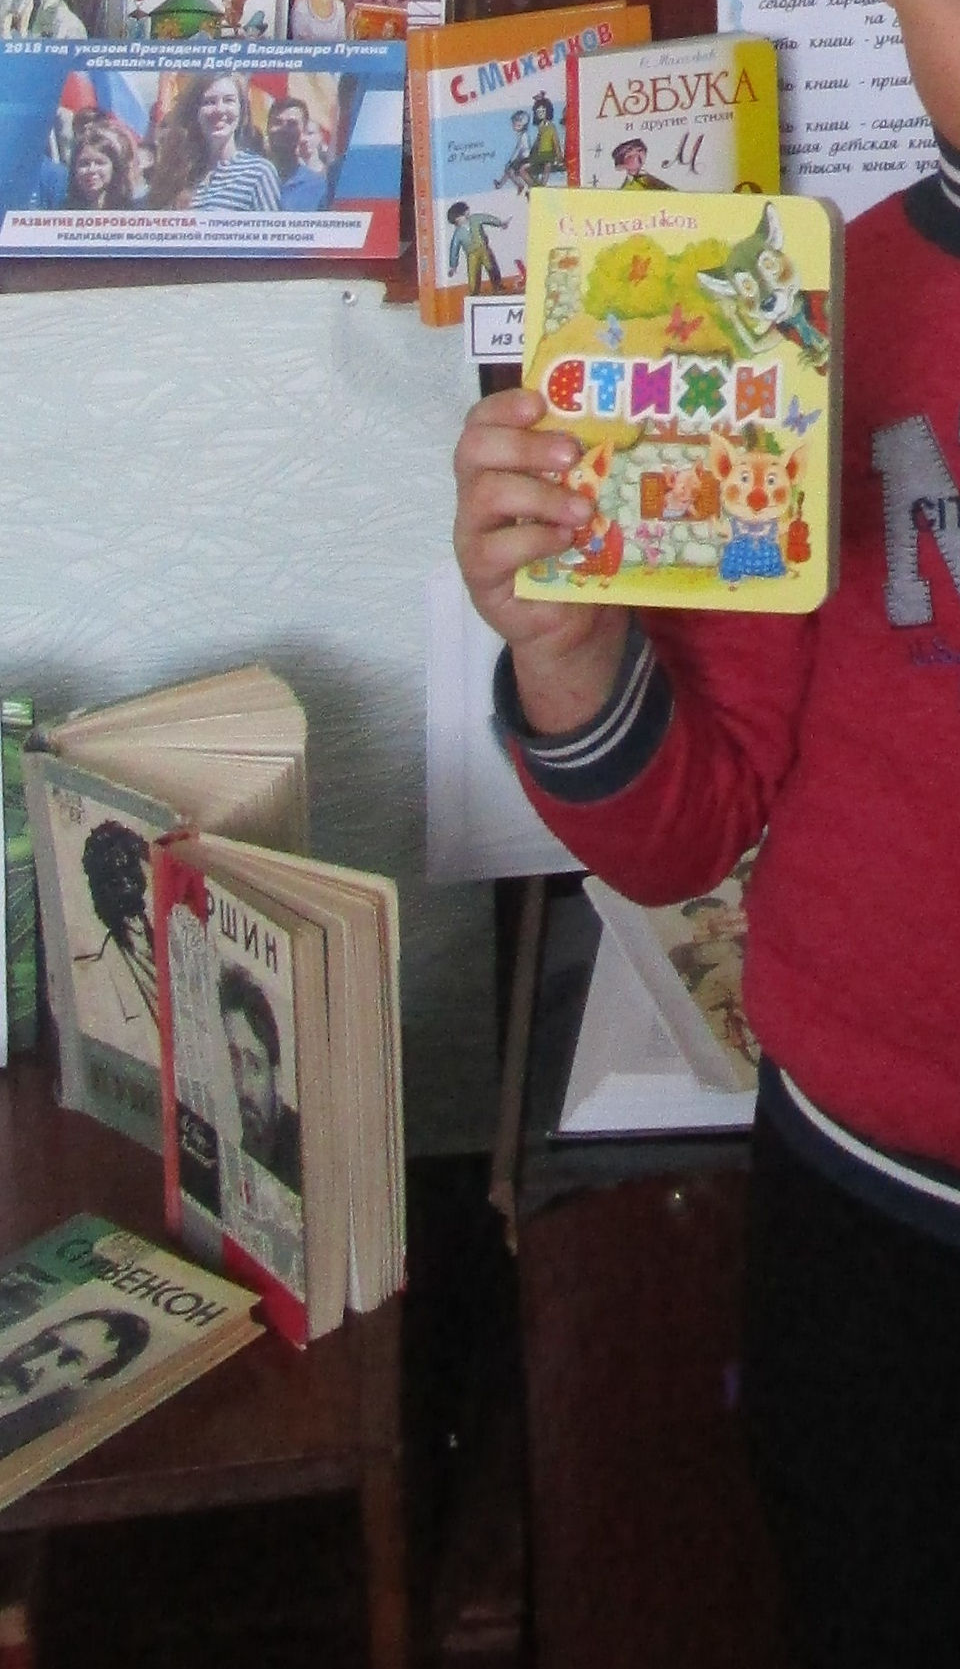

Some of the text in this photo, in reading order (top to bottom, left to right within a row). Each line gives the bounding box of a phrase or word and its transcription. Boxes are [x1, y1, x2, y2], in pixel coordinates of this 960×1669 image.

[596, 67, 760, 119] АЗБУКА
[625, 111, 734, 132] и другие стихи
[559, 208, 699, 238] С. Михалков
[547, 359, 780, 422] СТИХИ
